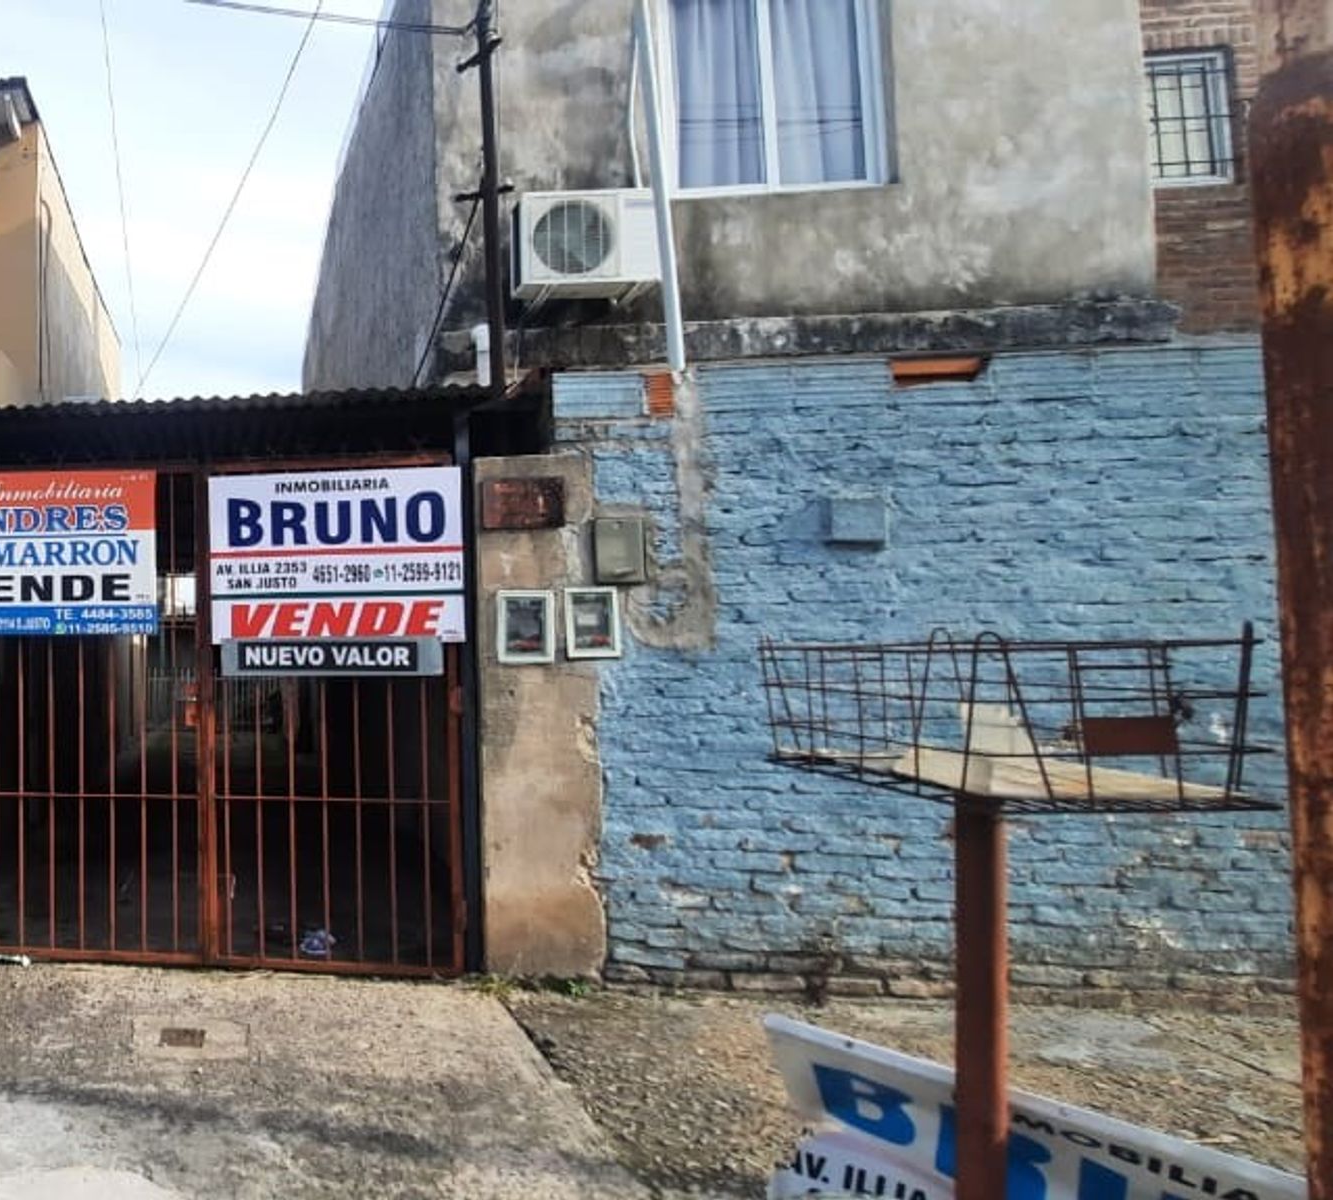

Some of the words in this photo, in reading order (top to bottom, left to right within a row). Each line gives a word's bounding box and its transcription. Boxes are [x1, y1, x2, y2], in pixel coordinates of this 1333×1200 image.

[275, 478, 389, 493] INMOBILIARIA
[227, 491, 446, 547] BRUNO
[239, 562, 270, 575] ILLIA
[274, 561, 308, 574] 2353
[227, 579, 252, 589] SAN
[256, 577, 297, 589] JUSTO
[230, 601, 444, 638] VENDE
[245, 648, 324, 666] NUEVO
[331, 646, 410, 666] VALOR
